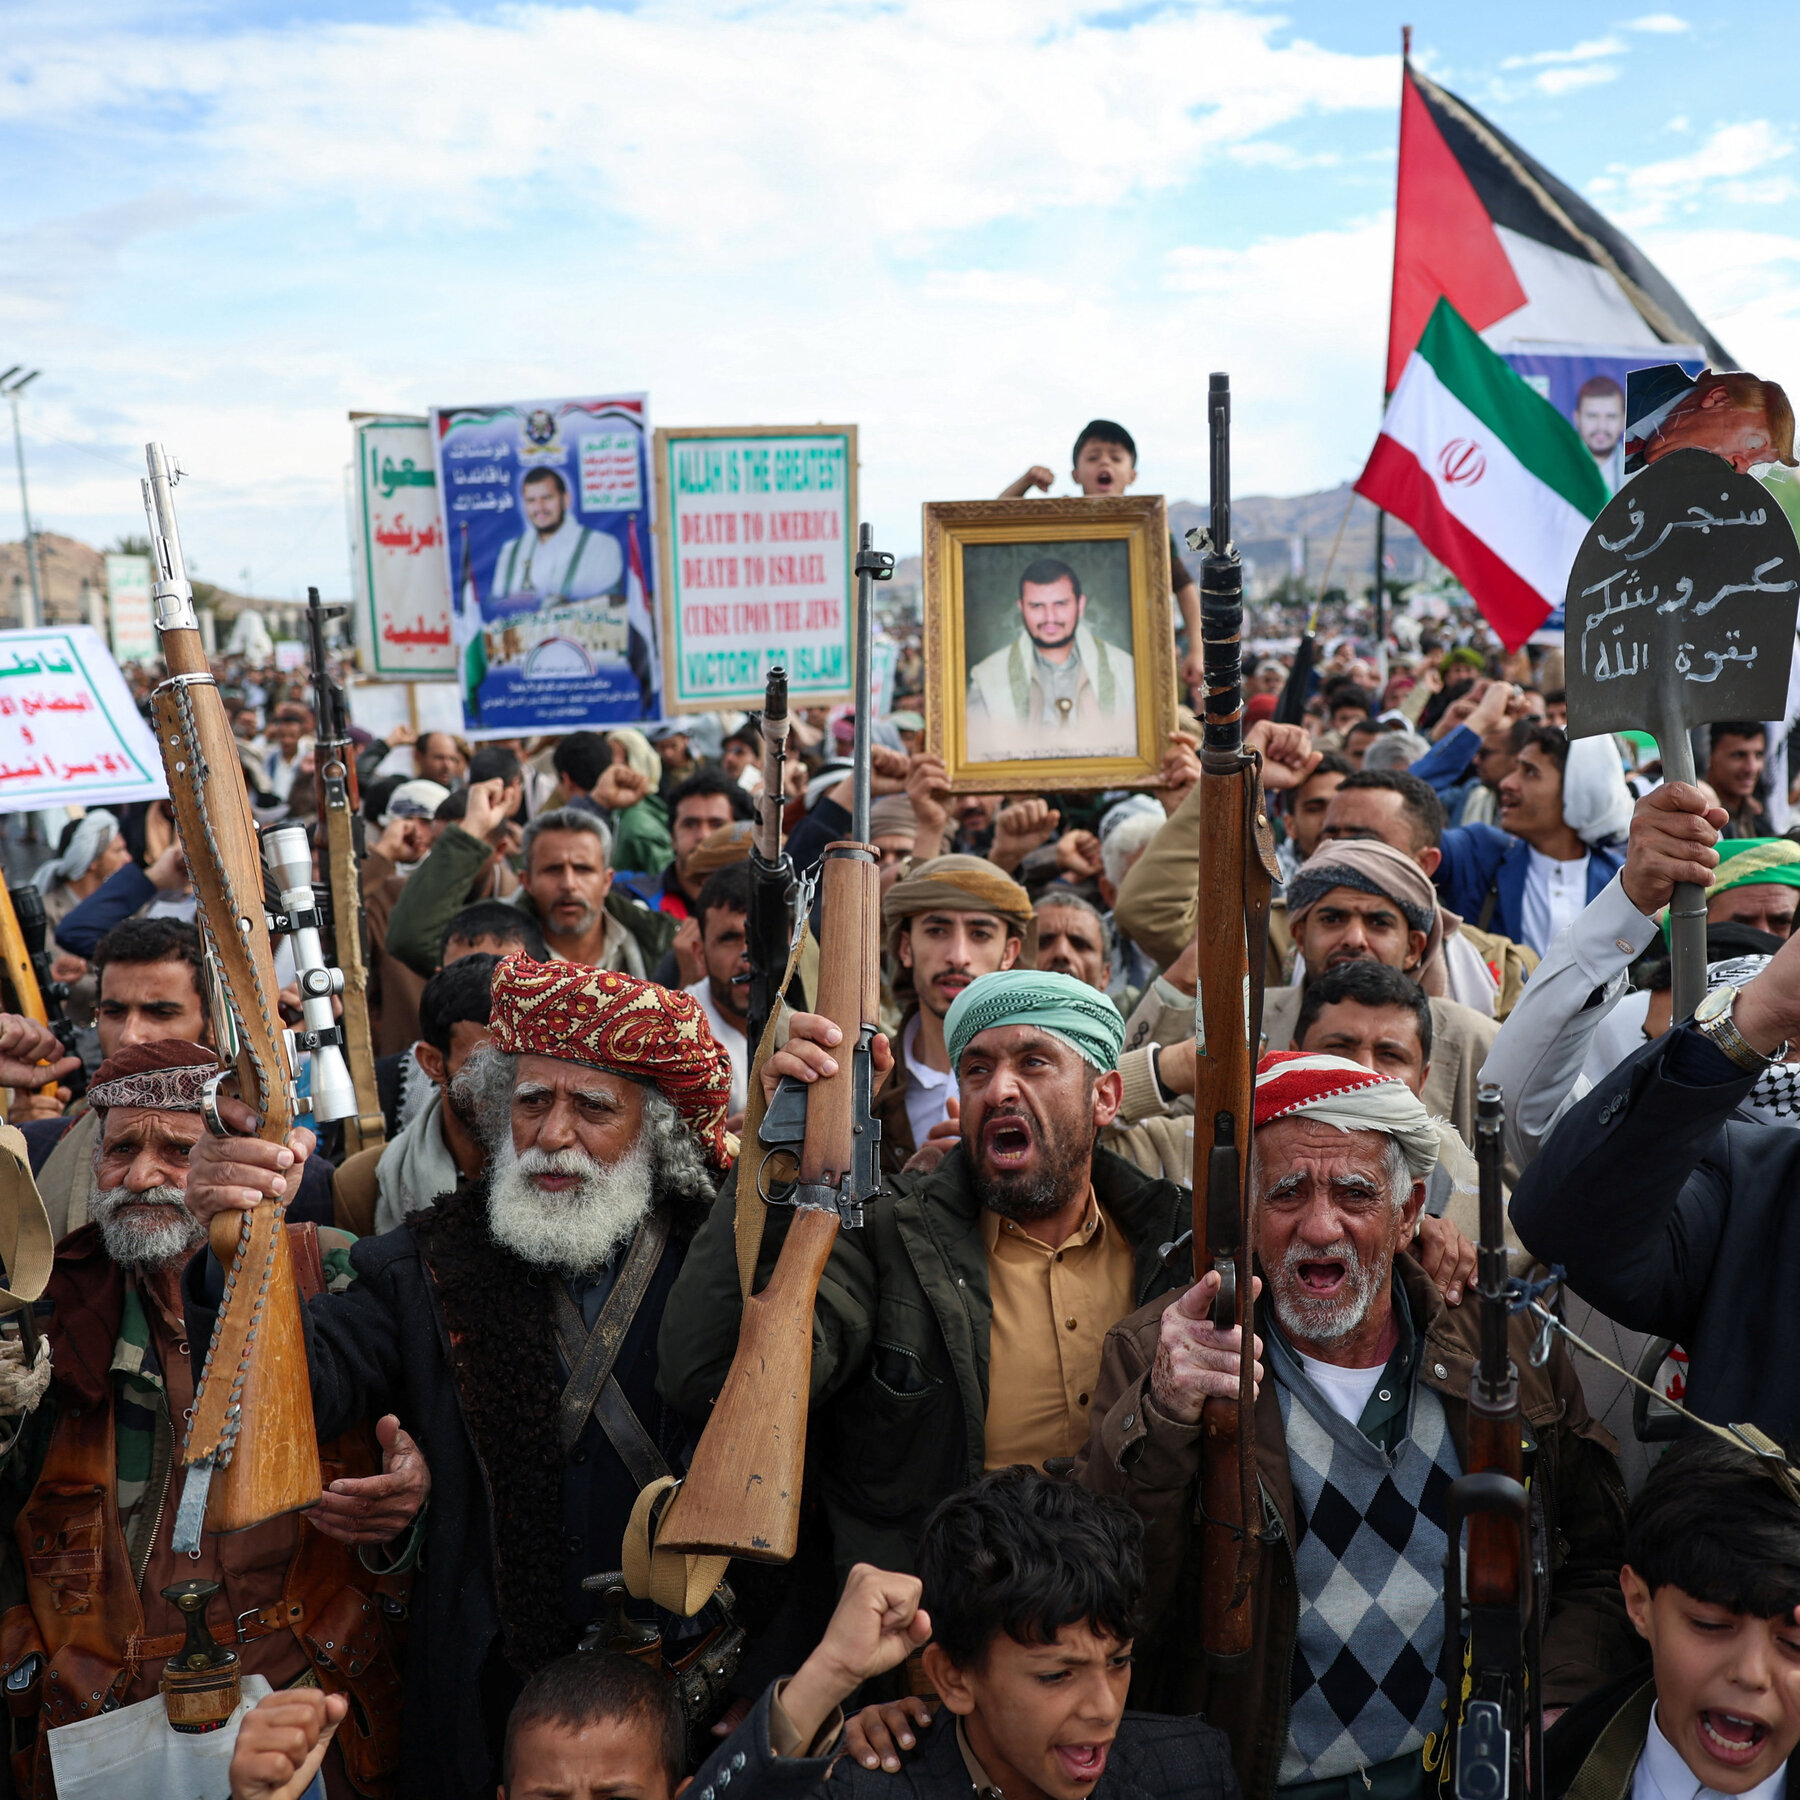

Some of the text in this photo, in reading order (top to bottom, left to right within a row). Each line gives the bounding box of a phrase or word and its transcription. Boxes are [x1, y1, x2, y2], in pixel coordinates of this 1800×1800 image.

[679, 448, 843, 494] ALLAH IS THE GREATEST
[681, 509, 839, 545] DEATH TO AMERICA
[683, 553, 827, 590] DEATH TO ISRAEL
[685, 598, 842, 637] CURSE UPON THE JEWS
[687, 650, 761, 688] VICTORY
[793, 645, 843, 682] ISLAM
[1673, 629, 1758, 682] بقوة
